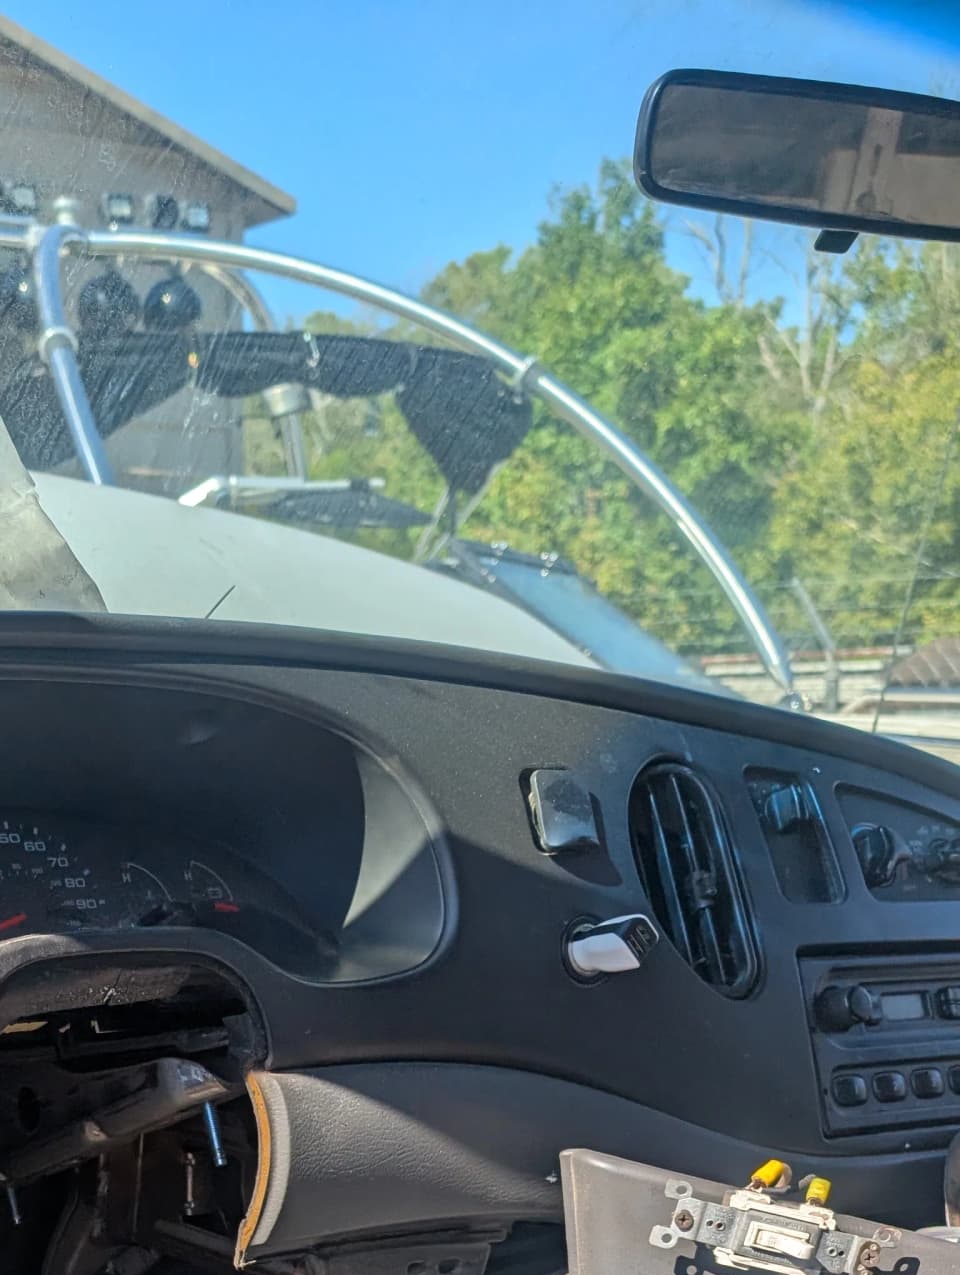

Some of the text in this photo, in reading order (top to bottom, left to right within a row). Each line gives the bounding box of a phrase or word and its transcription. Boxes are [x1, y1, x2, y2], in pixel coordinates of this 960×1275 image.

[24, 841, 46, 851] 60
[47, 857, 69, 868] 70
[64, 878, 86, 888] 80
[76, 899, 97, 909] 90
